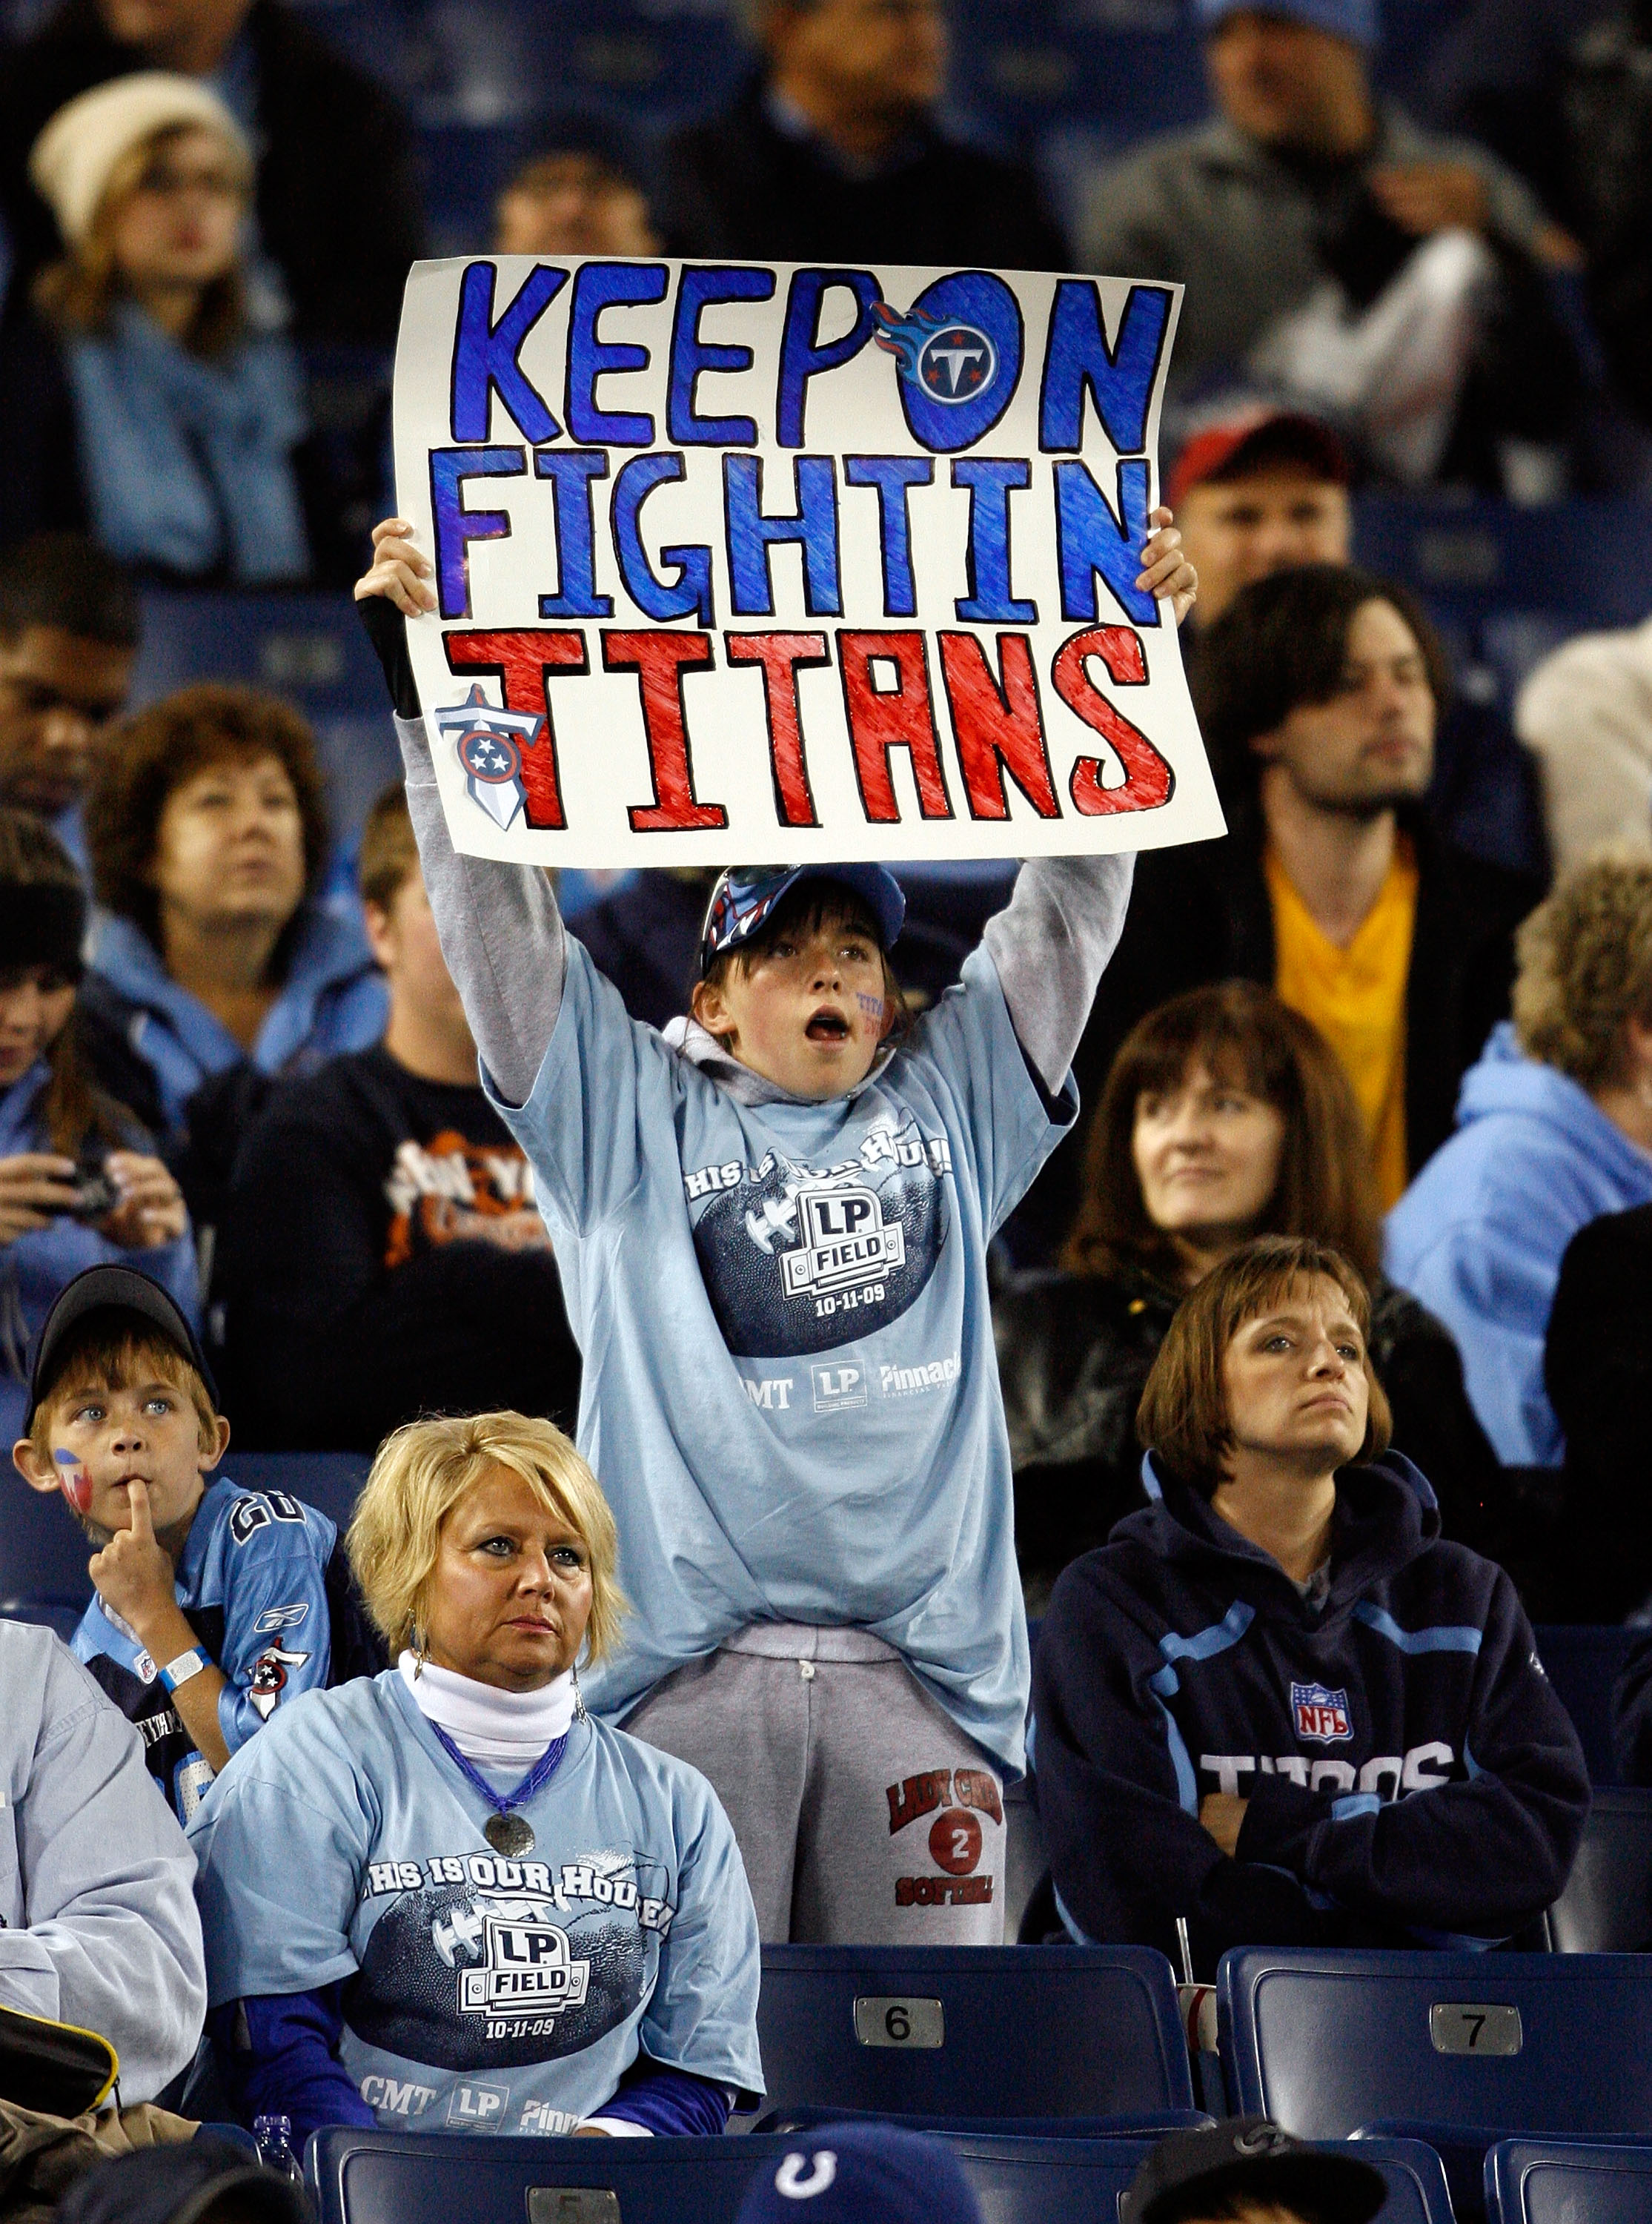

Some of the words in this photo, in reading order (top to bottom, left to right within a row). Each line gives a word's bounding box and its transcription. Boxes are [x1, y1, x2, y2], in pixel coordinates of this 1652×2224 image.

[450, 261, 883, 448] KEEP
[896, 270, 1172, 454] ON
[430, 446, 1161, 629] FIGHTIN
[442, 623, 1175, 833] TITANS
[815, 1199, 871, 1235] LP
[817, 1237, 881, 1271] FIELD
[815, 1283, 886, 1317] 10-11-09
[738, 1376, 793, 1409] MT
[820, 1369, 860, 1395] LP
[1298, 1706, 1347, 1736] NFL
[952, 1829, 969, 1858] 2
[363, 1861, 423, 1899] HIS
[428, 1856, 465, 1886] IS
[471, 1855, 553, 1895] OUR
[498, 1930, 557, 1964] LP
[495, 1970, 566, 1994] FIELD
[485, 2019, 554, 2039] 10-11-09
[886, 2005, 910, 2040] 6
[1462, 2014, 1486, 2047] 7
[361, 2076, 437, 2114] CMT
[460, 2088, 500, 2117] LP
